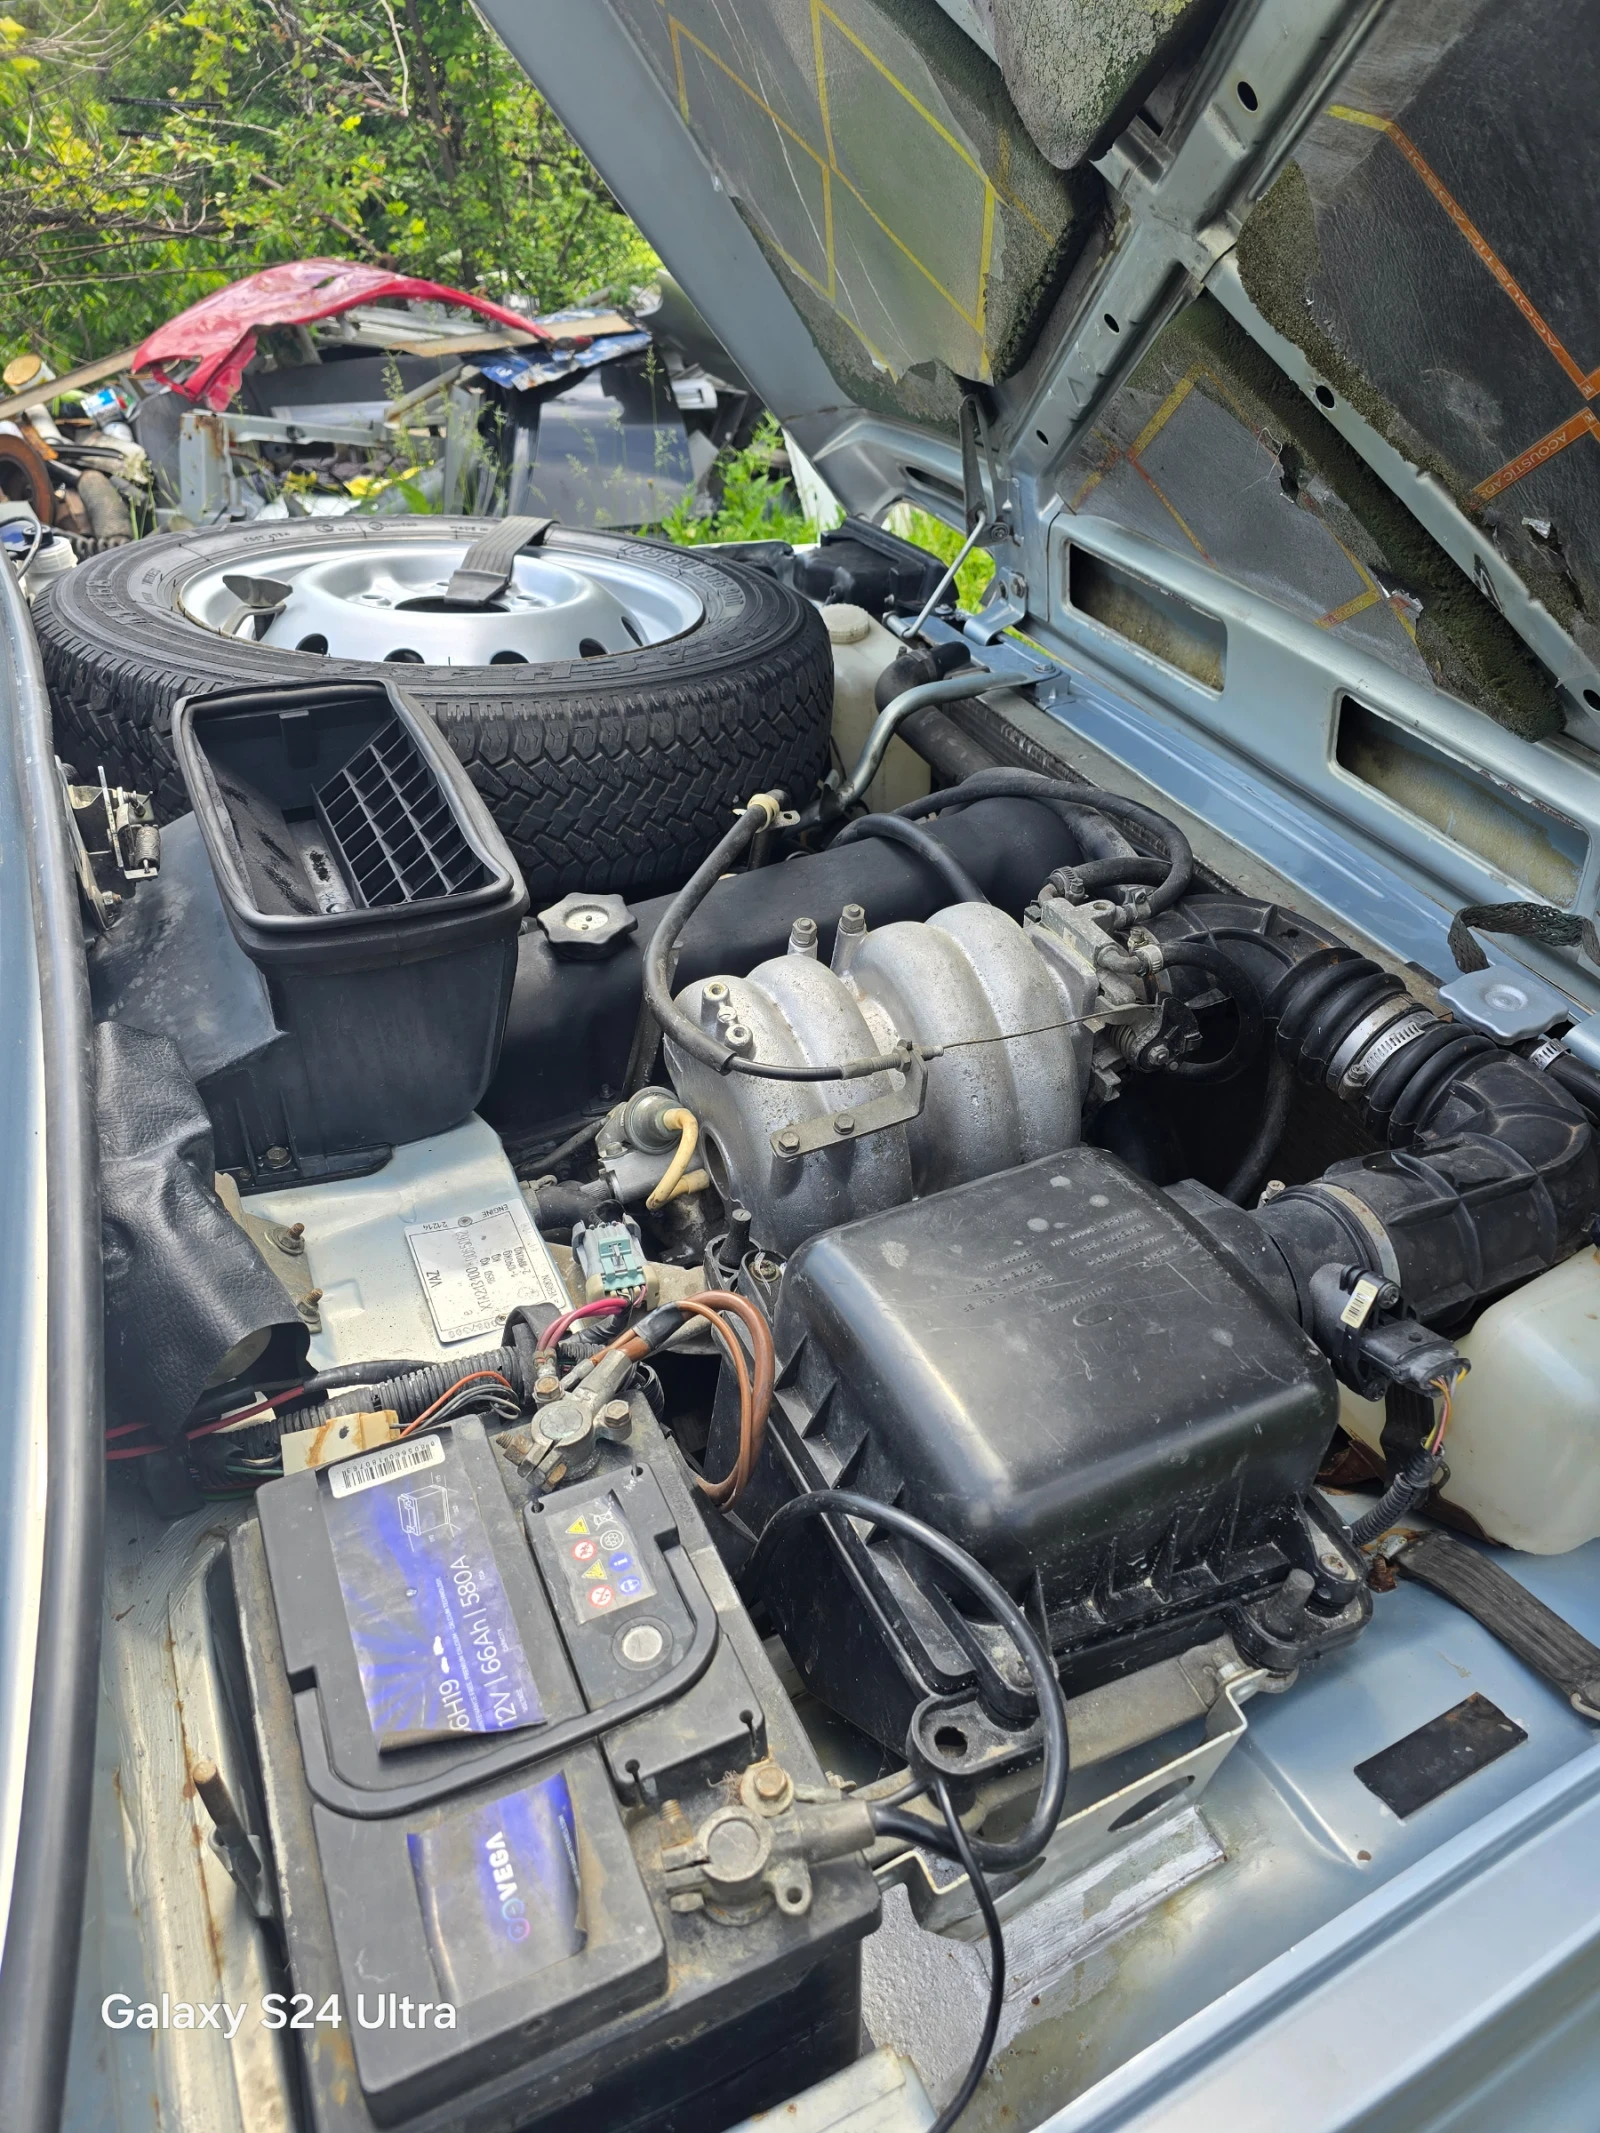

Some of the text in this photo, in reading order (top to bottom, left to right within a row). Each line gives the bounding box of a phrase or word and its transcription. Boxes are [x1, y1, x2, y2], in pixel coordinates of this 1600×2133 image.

[1465, 226, 1561, 350] ACOUSTIC
[1503, 430, 1567, 482] ACOUSTIC
[422, 1220, 447, 1230] 21214
[481, 1203, 509, 1217] ENGINE
[426, 1269, 443, 1288] VAZ
[541, 1274, 558, 1298] VERSION
[450, 1554, 480, 1608] 580A
[469, 1618, 502, 1675] 66Ah
[497, 1628, 510, 1653] CAPACITY
[438, 1678, 472, 1731] 6H19
[488, 1691, 518, 1728] 12V
[485, 1831, 518, 1901] VEGA
